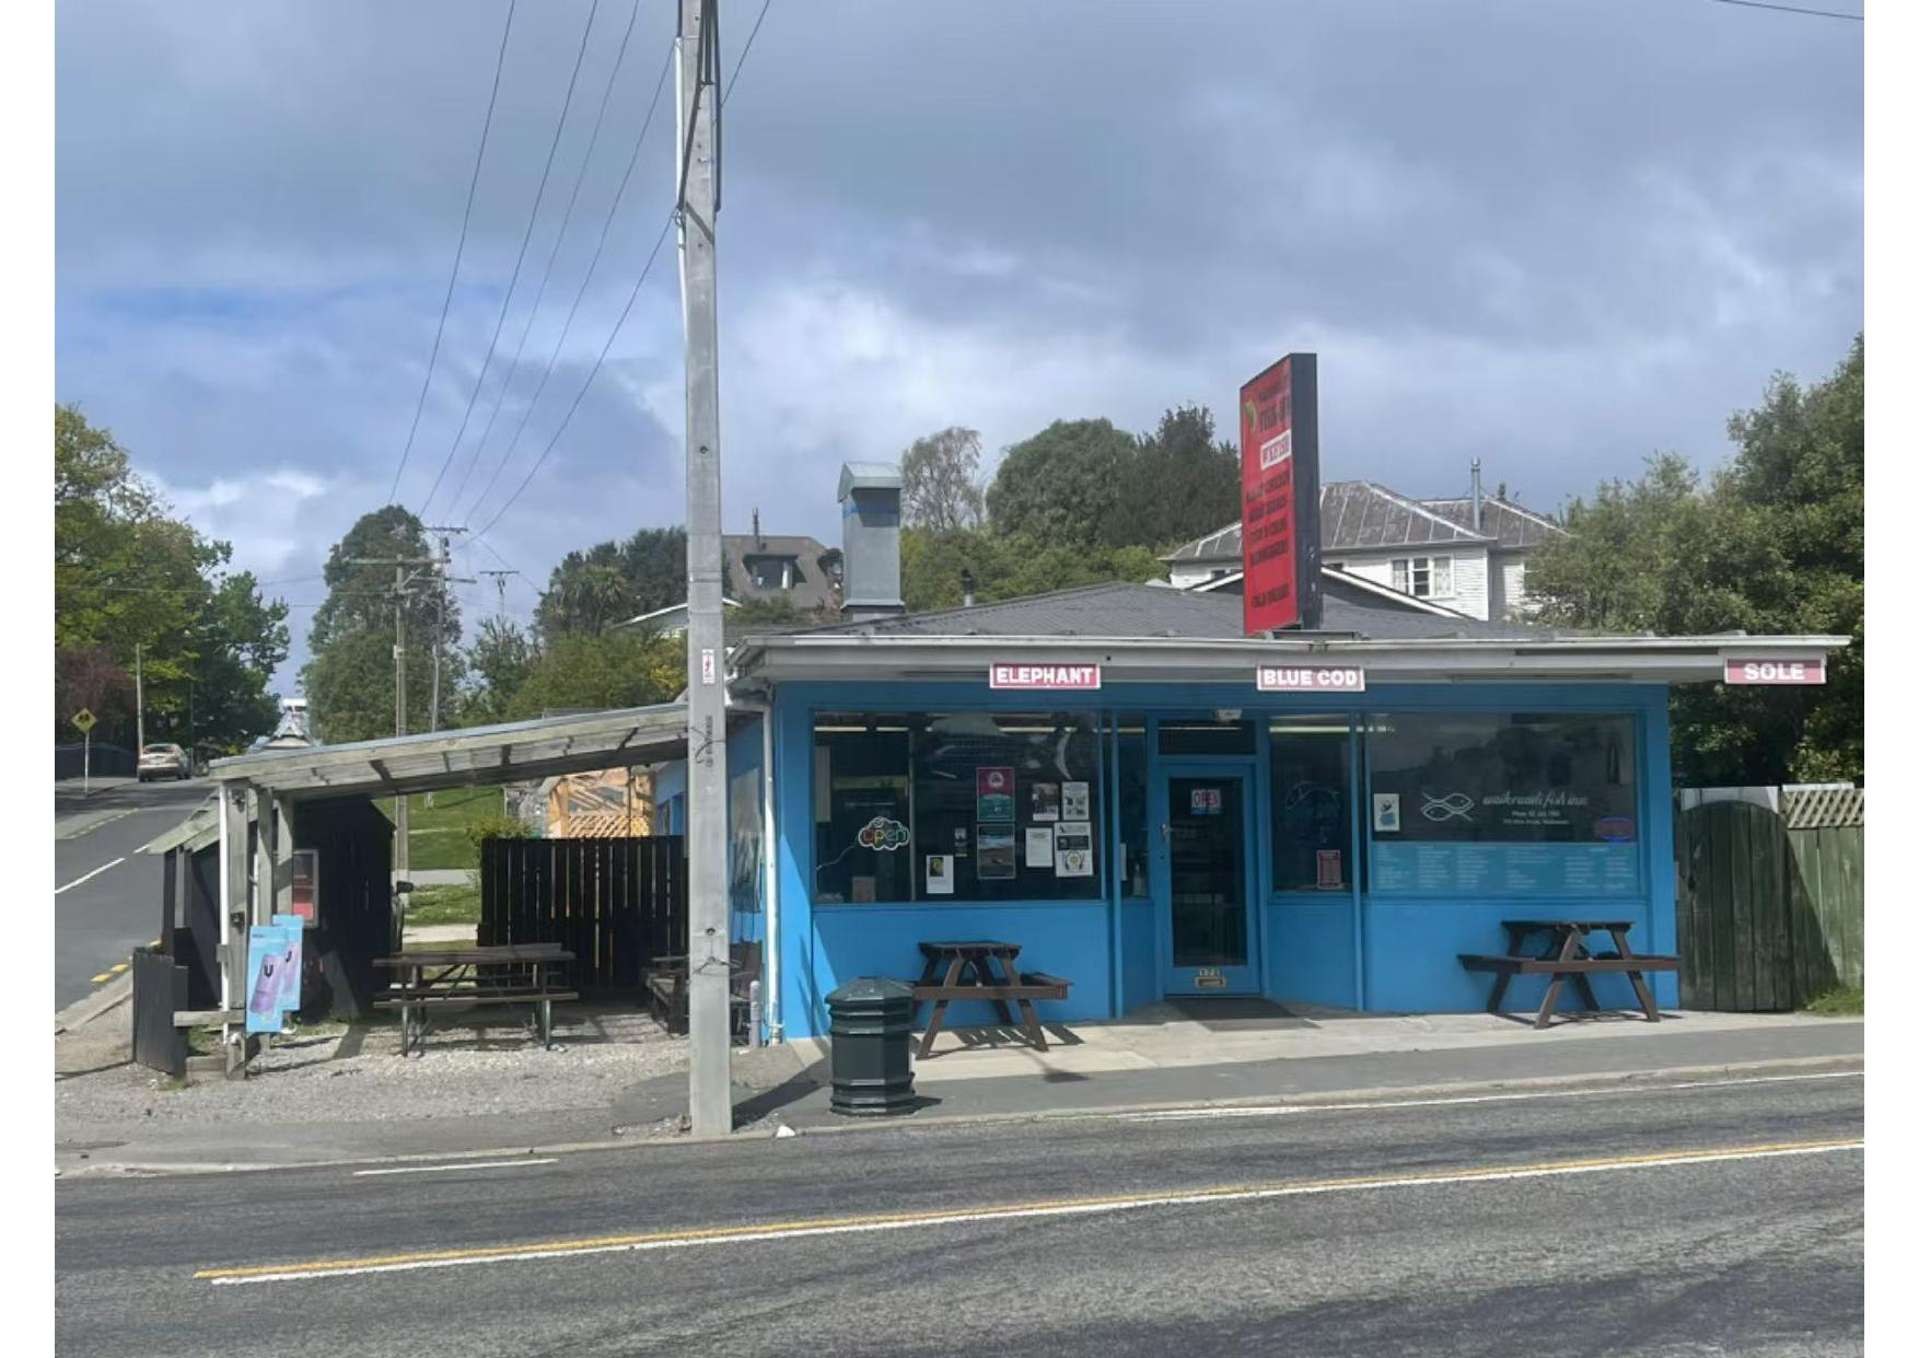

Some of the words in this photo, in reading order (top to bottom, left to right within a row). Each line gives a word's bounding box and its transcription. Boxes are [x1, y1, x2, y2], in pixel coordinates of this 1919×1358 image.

[996, 667, 1093, 684] ELEPHANT
[1263, 669, 1313, 686] BLUE
[1317, 669, 1358, 686] COD
[1743, 663, 1805, 681] SOLE
